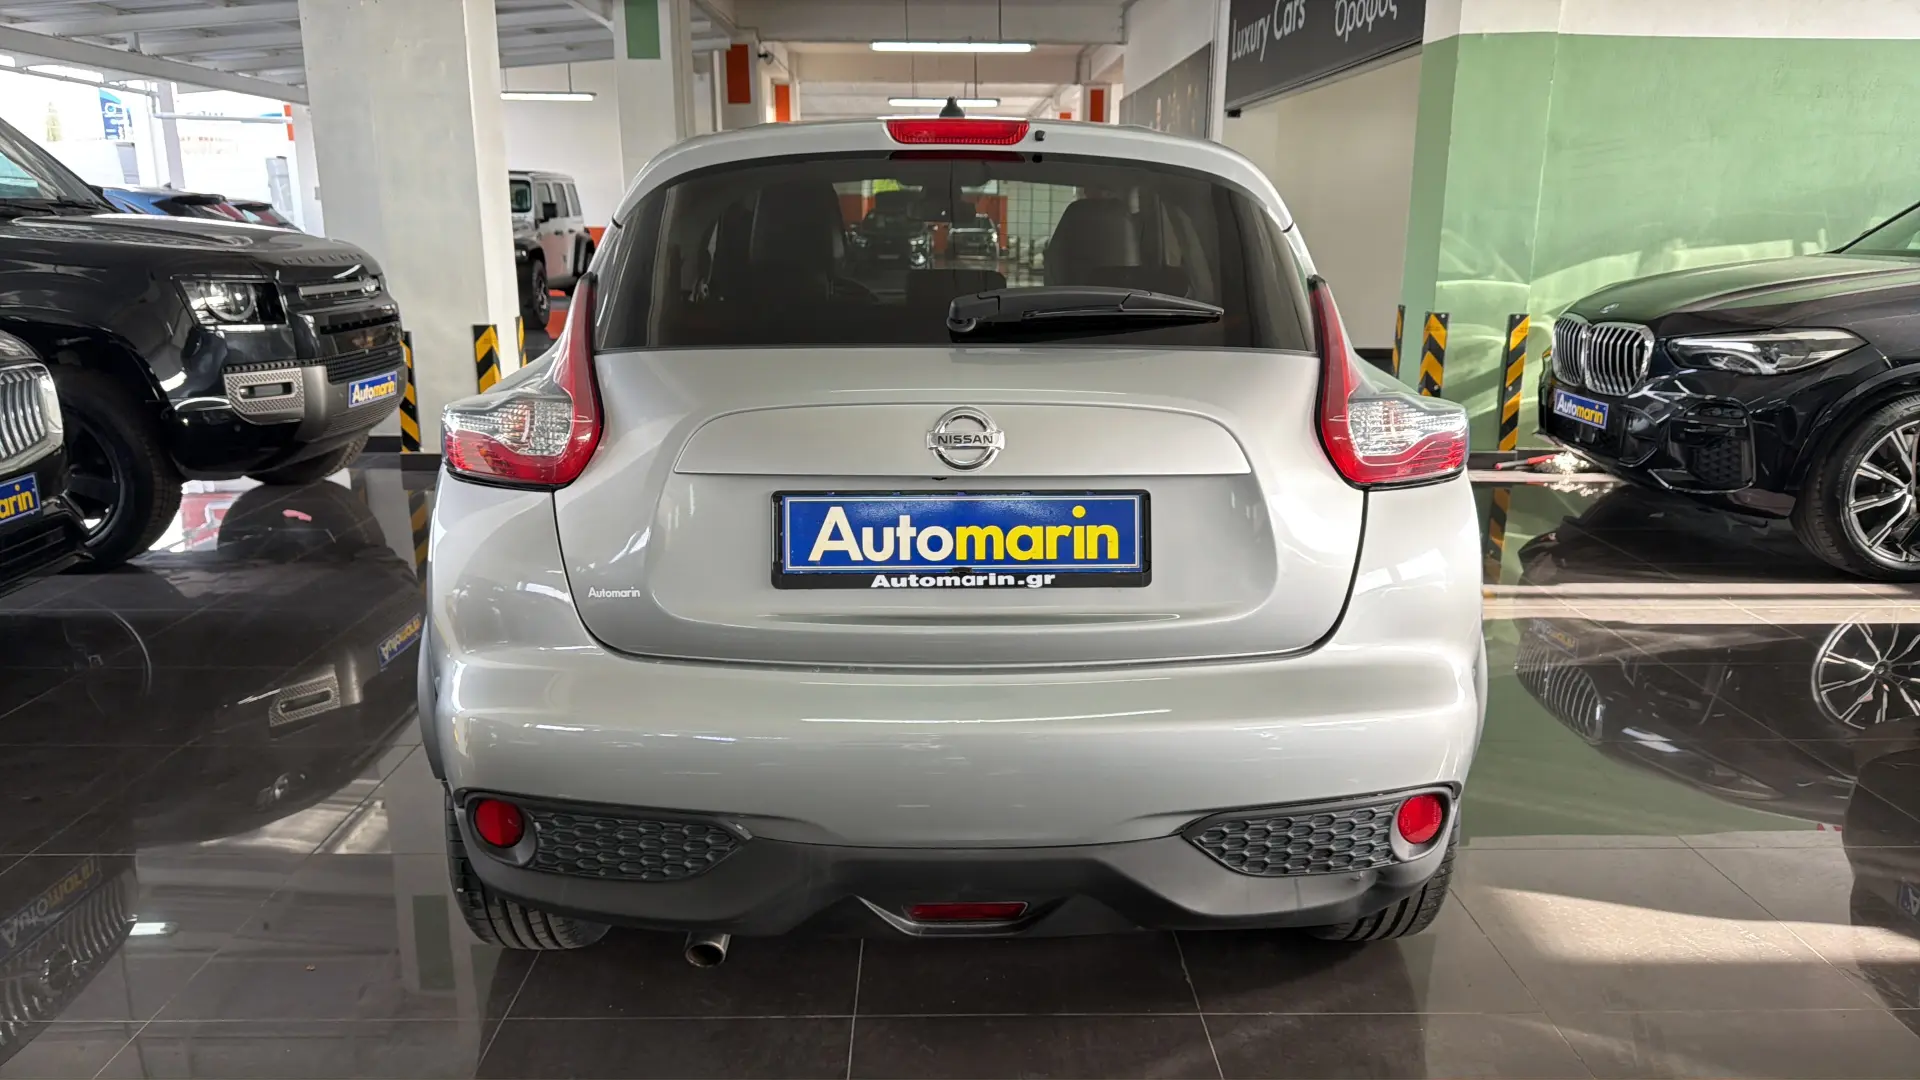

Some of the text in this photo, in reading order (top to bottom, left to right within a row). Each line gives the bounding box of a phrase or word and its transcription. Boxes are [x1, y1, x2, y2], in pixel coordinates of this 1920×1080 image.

[1232, 0, 1305, 62] Luxury Cars
[352, 376, 395, 404] Automarin
[1557, 393, 1604, 425] Automarin
[937, 434, 994, 446] NISSAN
[808, 505, 1119, 562] Automarin
[588, 586, 641, 598] Automarin
[871, 573, 1056, 588] Automarin.gr
